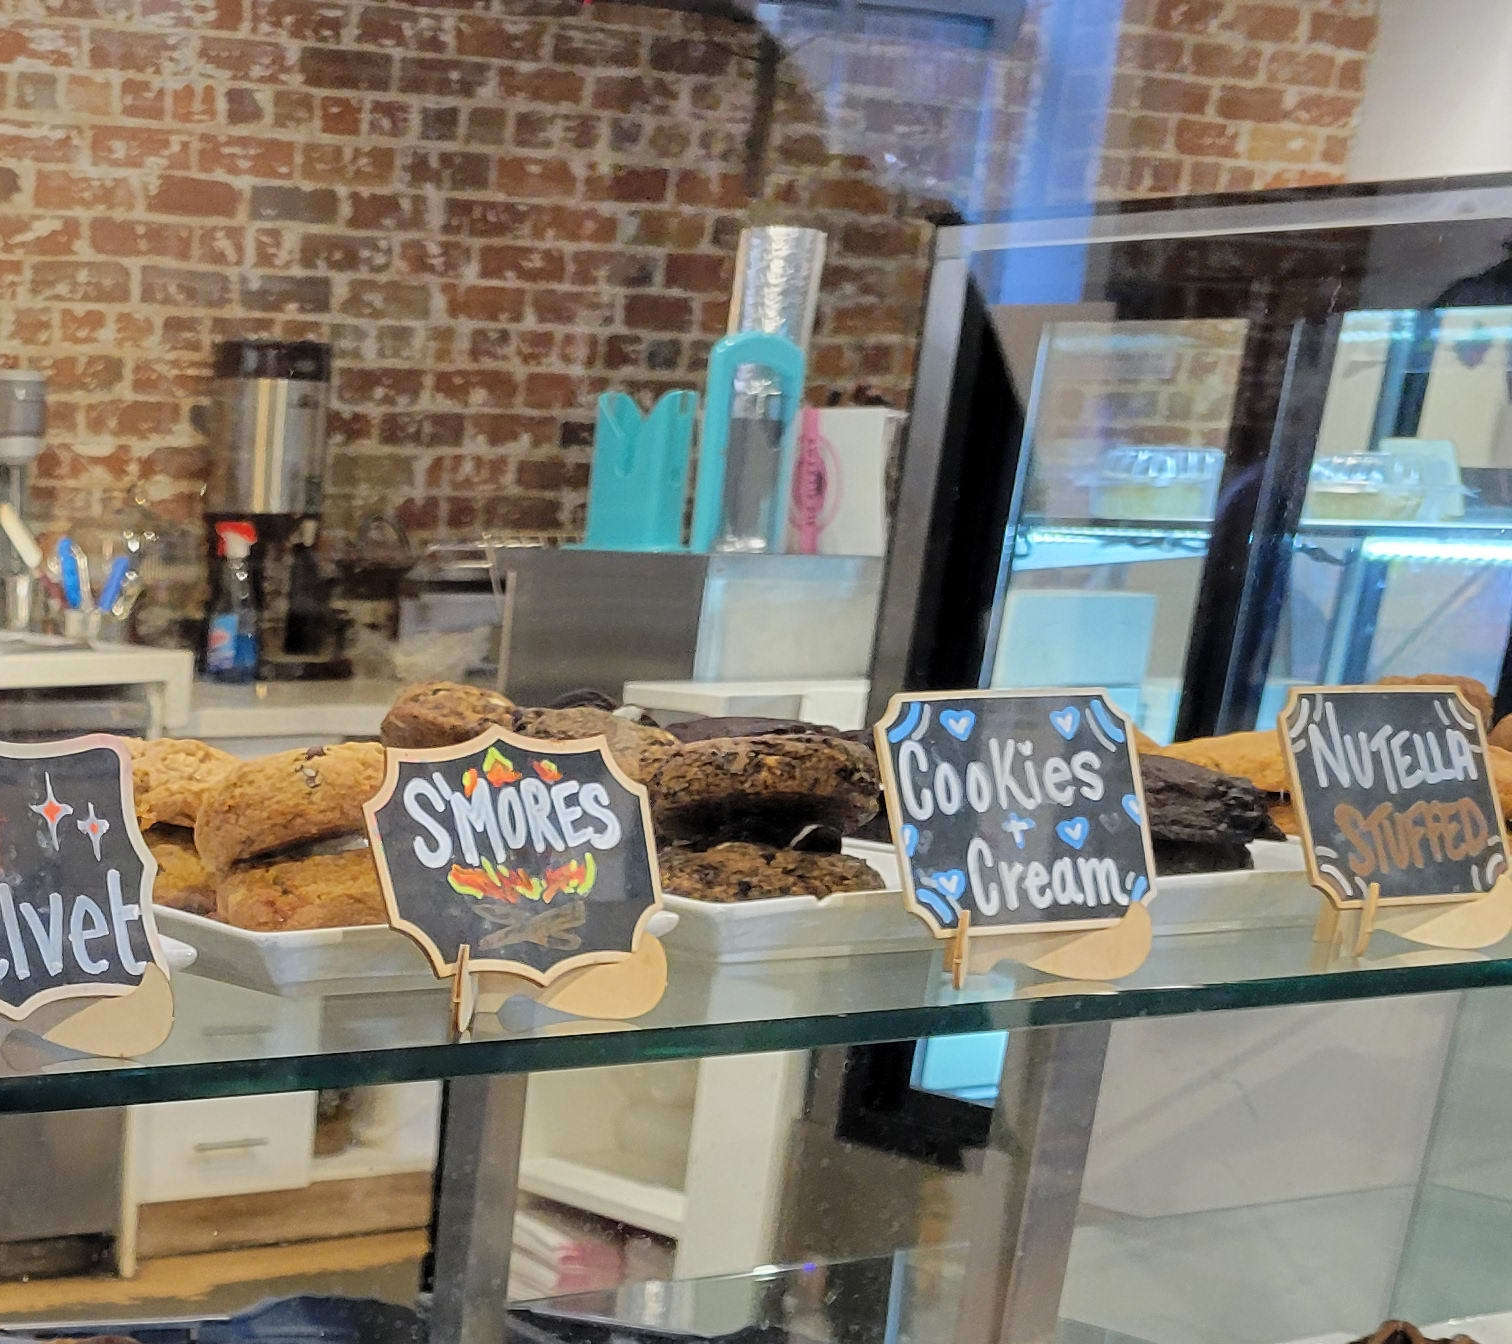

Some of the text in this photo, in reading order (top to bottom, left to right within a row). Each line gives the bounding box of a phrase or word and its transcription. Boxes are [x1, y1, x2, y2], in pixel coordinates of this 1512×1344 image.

[1308, 701, 1478, 794] NUTELLA
[403, 772, 622, 868] S'MORES
[1334, 797, 1488, 877] STUFFED
[967, 837, 1130, 916] Cream
